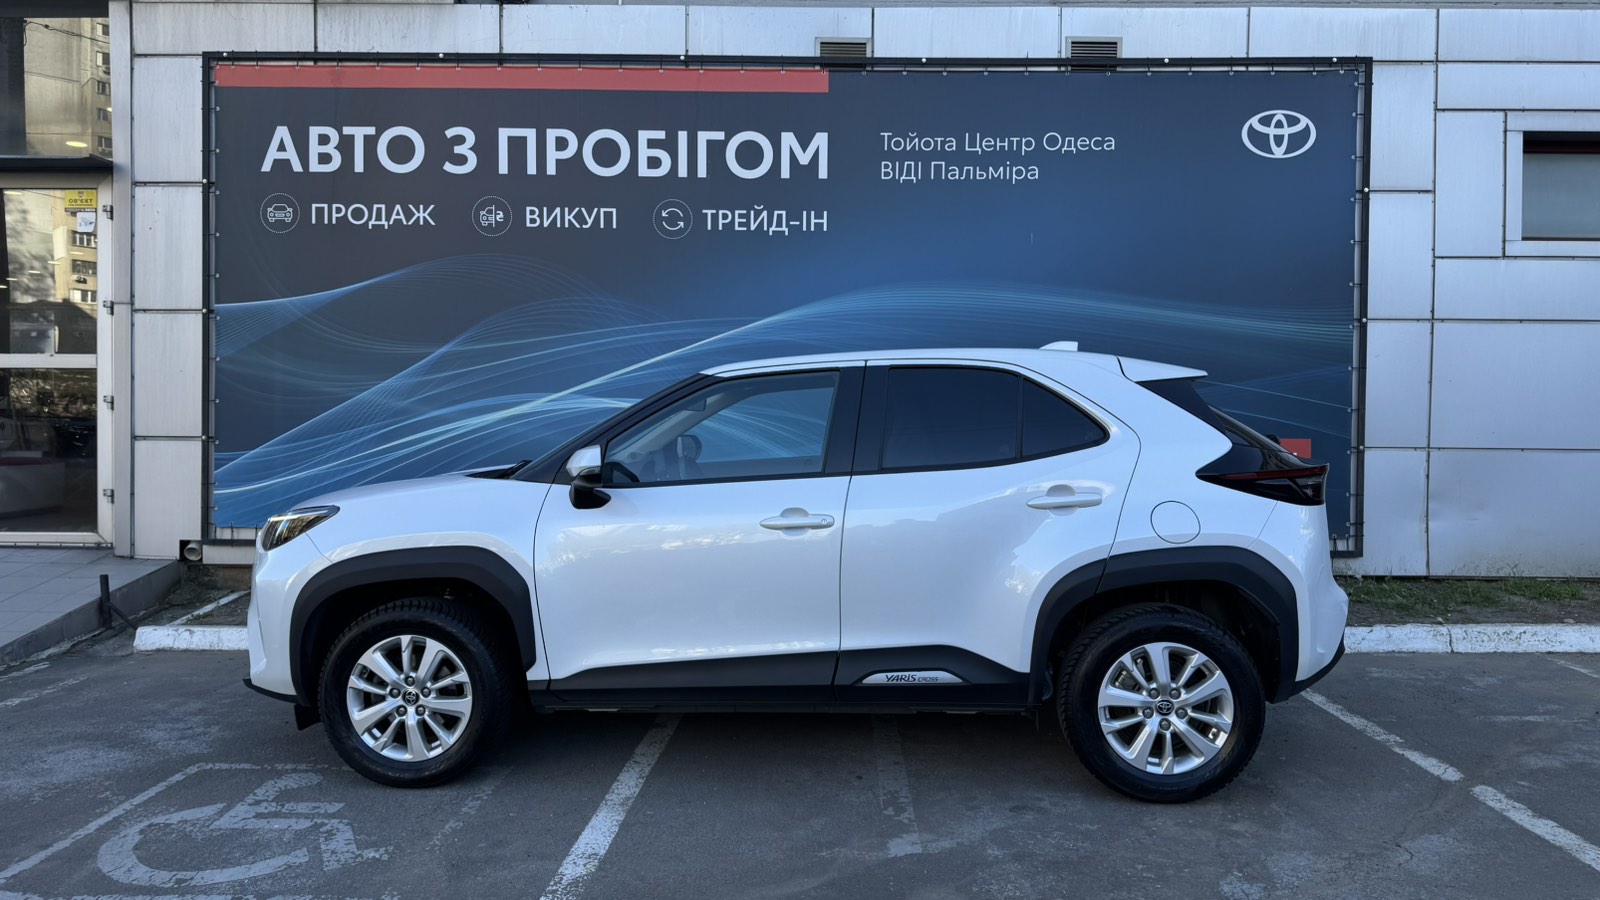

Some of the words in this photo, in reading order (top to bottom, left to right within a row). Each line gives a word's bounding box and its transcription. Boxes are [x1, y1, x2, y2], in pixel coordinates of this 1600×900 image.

[260, 126, 426, 174] АВТО
[443, 126, 478, 175] З
[498, 127, 829, 180] ПРОБІГОМ
[880, 132, 956, 152] Тойота
[965, 132, 1036, 156] Центр
[1043, 131, 1116, 154] Одеса
[880, 161, 922, 184] ВІДІ
[930, 161, 1040, 185] Пальміра
[311, 203, 436, 230] ПРОДАЖ
[525, 206, 617, 229] ВИКУП
[701, 204, 828, 236] ТРЕЙД-ІН
